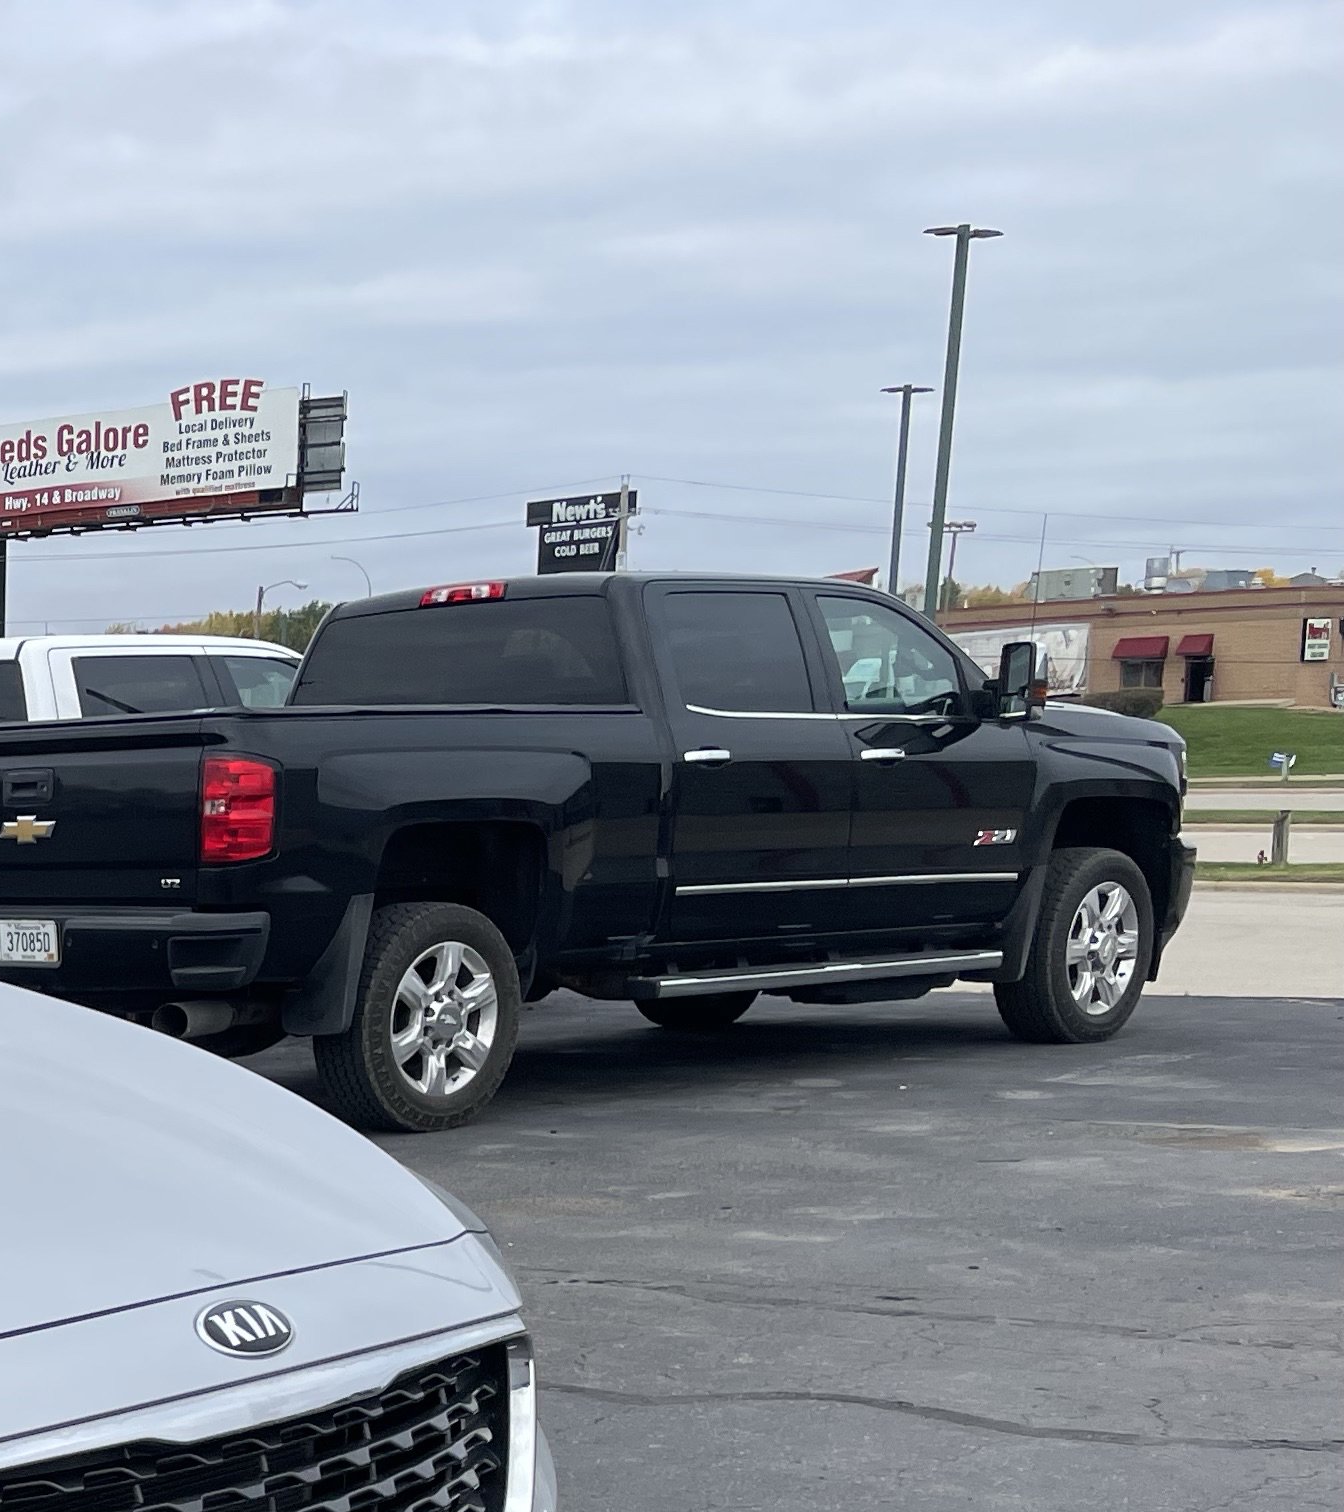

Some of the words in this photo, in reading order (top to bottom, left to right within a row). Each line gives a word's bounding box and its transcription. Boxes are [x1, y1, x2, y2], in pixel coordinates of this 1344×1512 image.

[170, 379, 265, 422] FREE
[178, 420, 208, 435] Local
[210, 416, 255, 432] Delivery
[57, 421, 150, 457] Galore
[162, 440, 183, 454] Bed
[185, 437, 219, 451] Frame
[221, 433, 230, 447] &
[233, 430, 271, 445] Sheets
[1, 459, 61, 486] Leather
[65, 452, 79, 473] &
[85, 450, 127, 471] More
[165, 454, 213, 470] Mattress
[215, 447, 268, 464] Protector
[160, 472, 202, 487] Memory
[205, 468, 235, 482] Foam
[238, 463, 273, 478] Pillow
[4, 495, 31, 512] Hwy.
[35, 492, 49, 507] 14
[52, 490, 61, 505] &
[64, 485, 122, 503] Broadway
[552, 496, 606, 523] Newt's
[544, 530, 572, 544] GREAT
[573, 526, 613, 541] BURGERS
[554, 544, 577, 557] COLD
[579, 542, 600, 555] BEER
[208, 1304, 290, 1347] KIA
